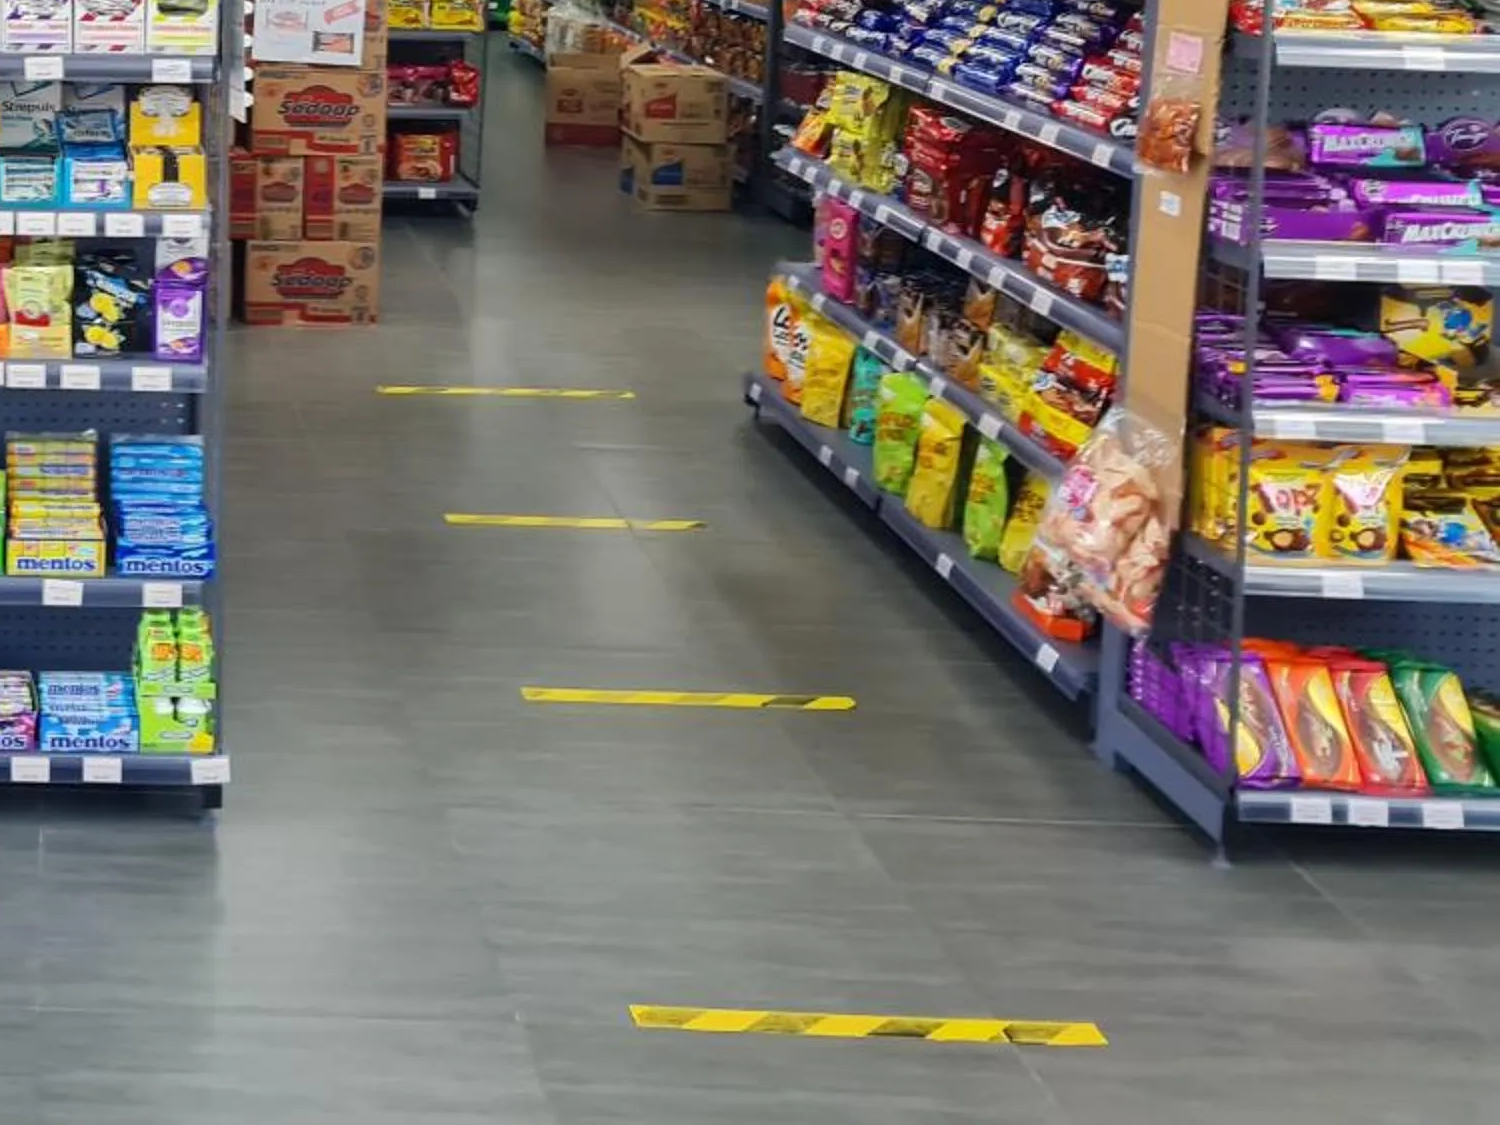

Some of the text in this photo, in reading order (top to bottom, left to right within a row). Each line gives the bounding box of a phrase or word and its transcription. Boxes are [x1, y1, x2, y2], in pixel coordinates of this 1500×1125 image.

[1, 100, 57, 115] Strepsils
[16, 556, 97, 573] mentos
[125, 559, 207, 575] mentos
[50, 734, 132, 750] mentos
